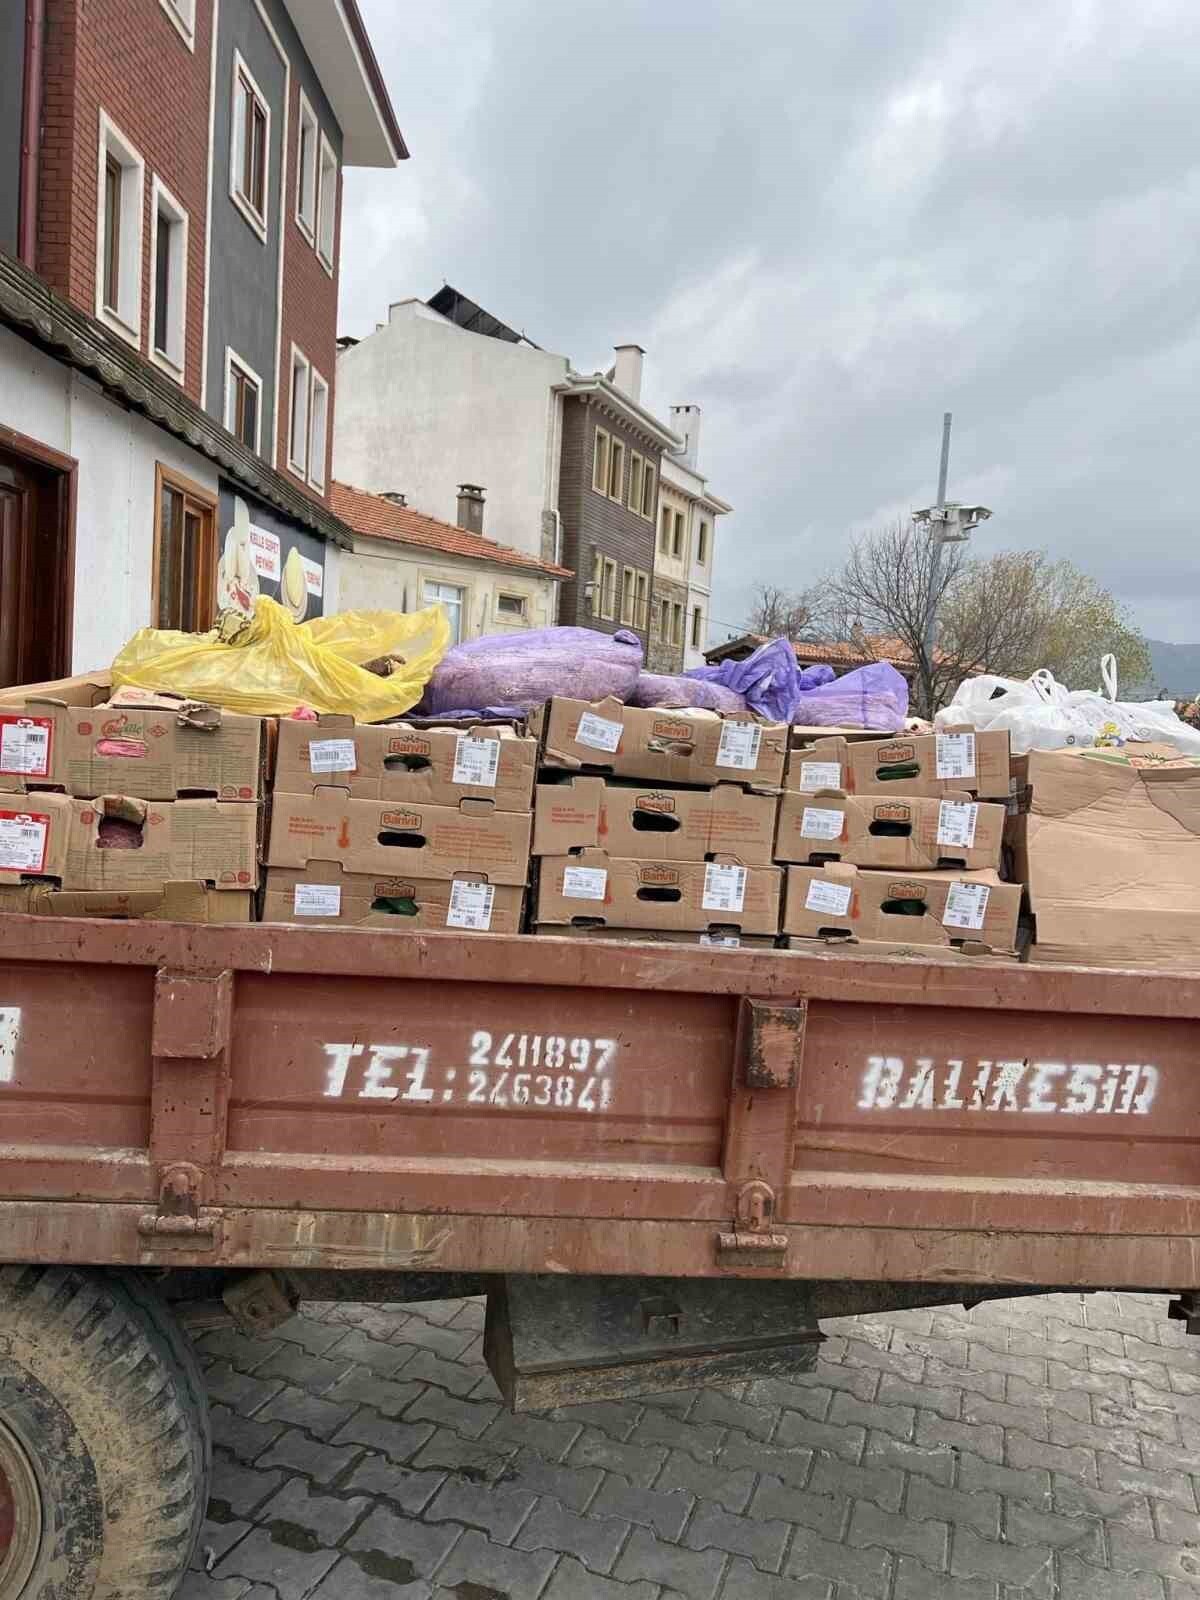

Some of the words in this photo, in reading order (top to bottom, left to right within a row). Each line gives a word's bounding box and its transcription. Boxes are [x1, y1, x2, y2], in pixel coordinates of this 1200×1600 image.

[655, 723, 688, 737] Banvit
[391, 741, 428, 754] Banvit
[382, 814, 418, 826] Banvit
[469, 1031, 618, 1072] 2411897
